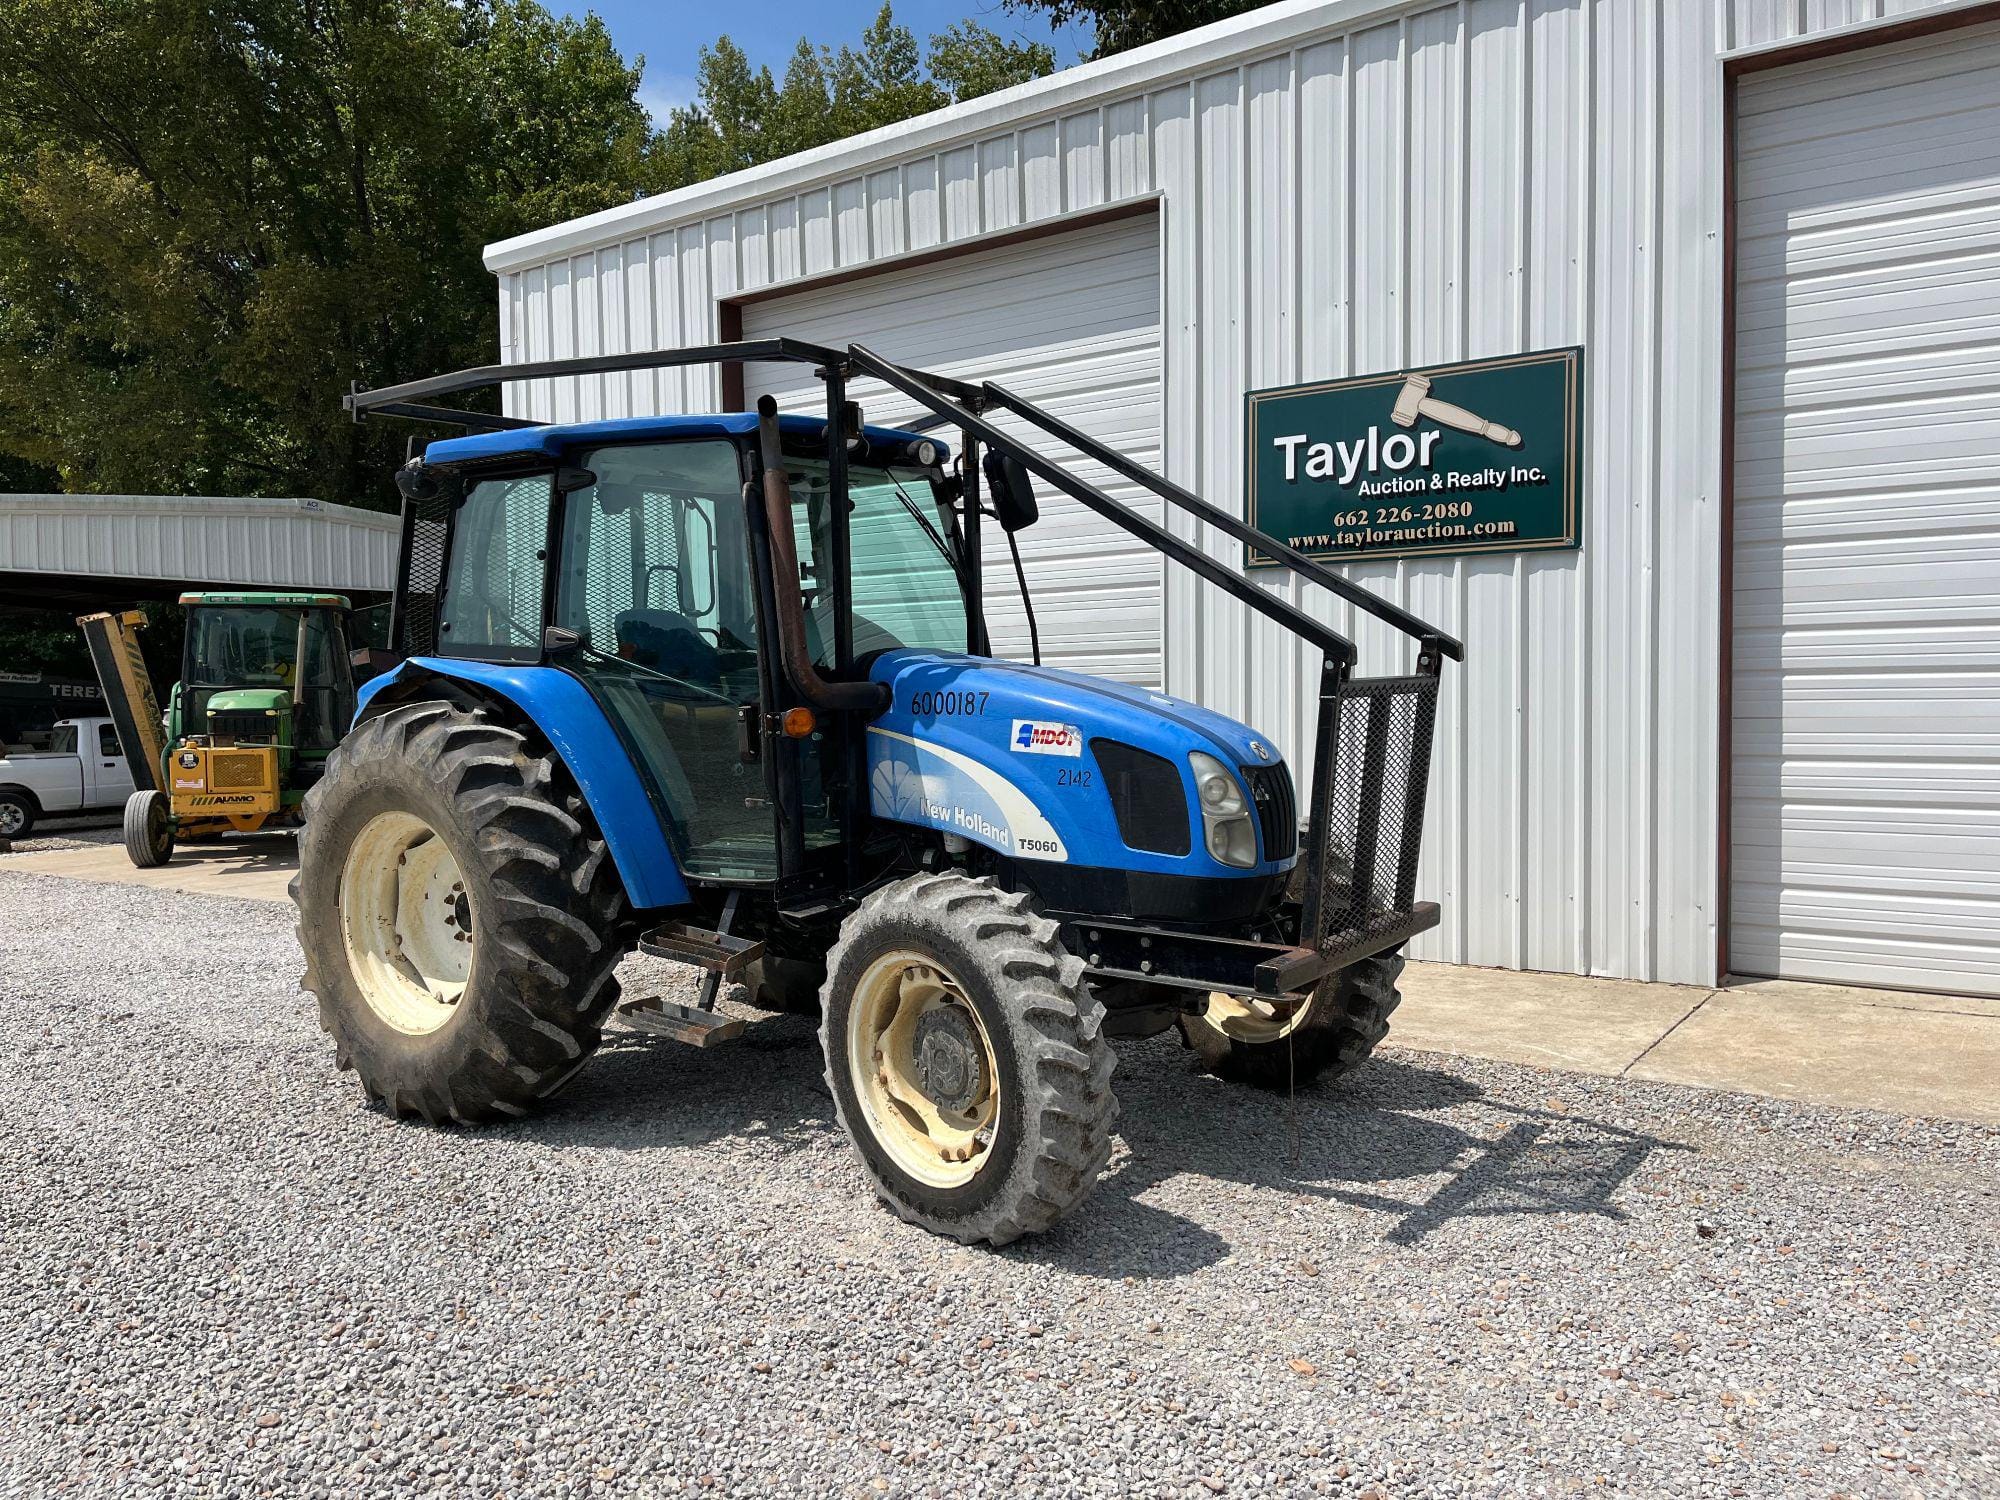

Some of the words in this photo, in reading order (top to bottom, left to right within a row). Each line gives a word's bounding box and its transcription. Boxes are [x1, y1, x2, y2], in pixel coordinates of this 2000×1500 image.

[1273, 425, 1440, 485] Taylor
[1358, 477, 1426, 496] Auction
[1430, 473, 1443, 490] &
[1447, 468, 1506, 488] Realty
[1510, 465, 1546, 483] Inc.
[1333, 509, 1369, 527] 662
[1376, 501, 1473, 525] 226-2080
[1288, 519, 1515, 548] www.taylorauction.com
[911, 691, 990, 716] 6000187
[1057, 768, 1092, 788] 2142
[921, 798, 951, 821] New
[954, 805, 1008, 846] Holland
[1018, 838, 1058, 853] T5060
